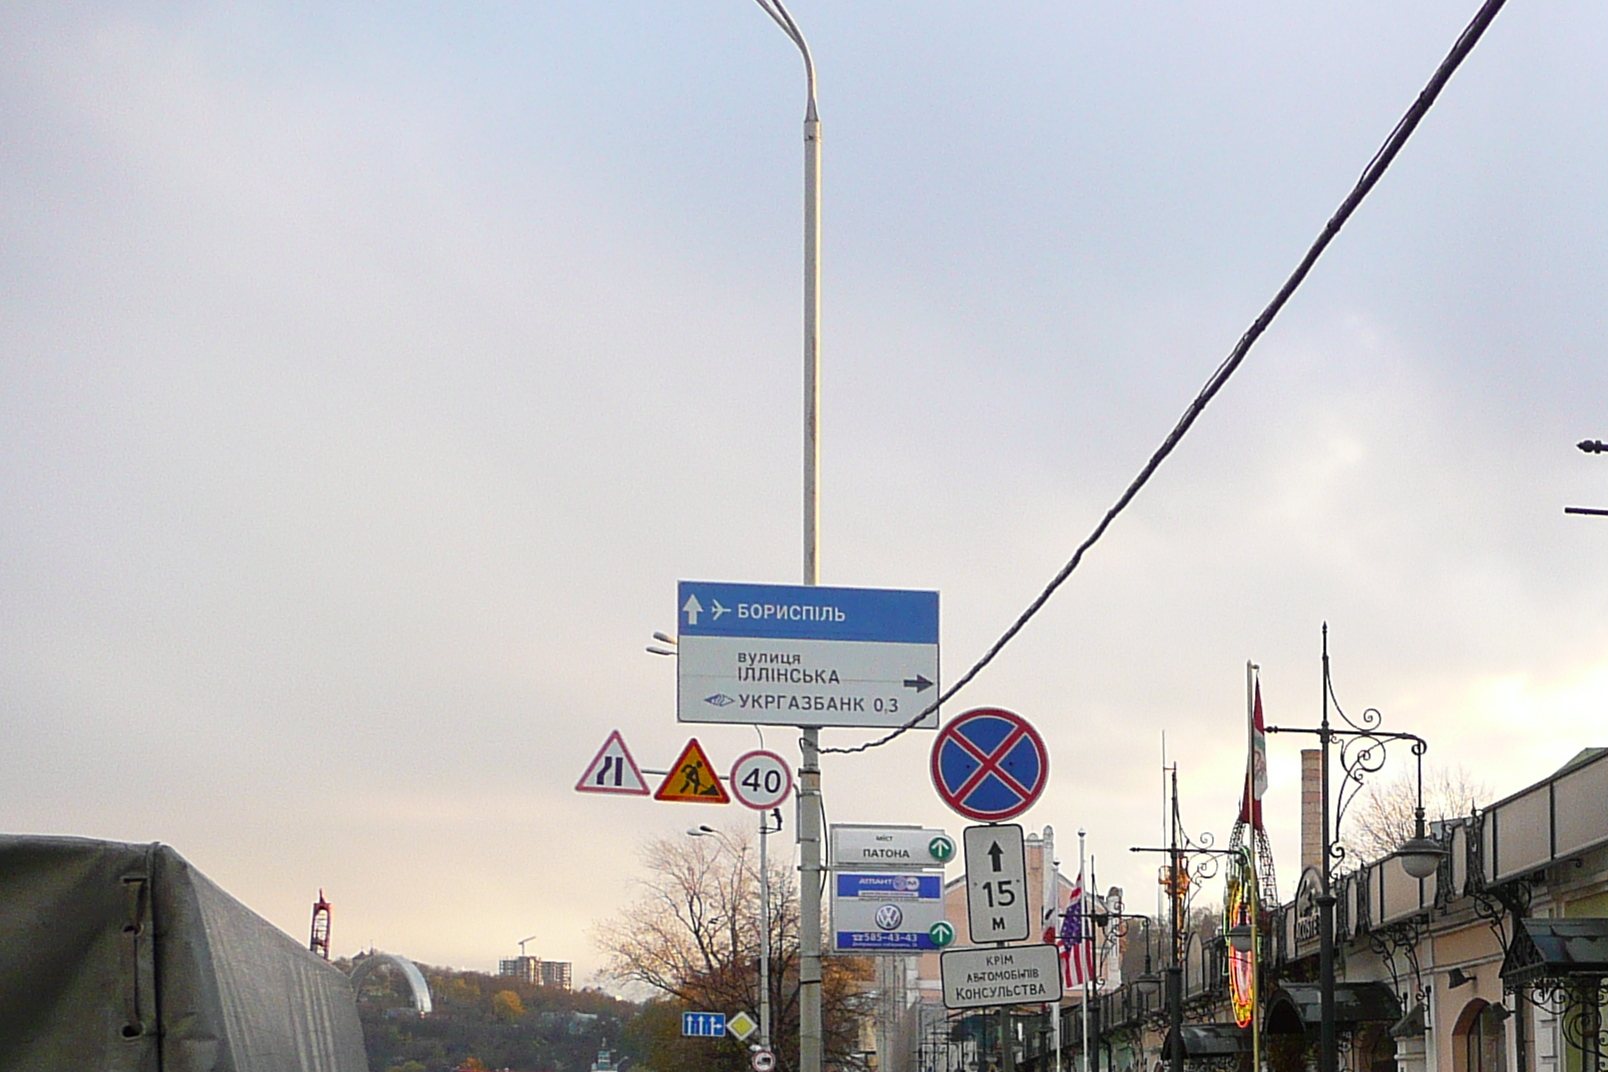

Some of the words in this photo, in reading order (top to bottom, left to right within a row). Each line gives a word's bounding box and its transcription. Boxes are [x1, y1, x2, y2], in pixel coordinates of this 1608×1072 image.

[738, 603, 846, 622] БОРИСПІЛЬ
[738, 652, 801, 667] вулиця
[738, 667, 840, 685] ІЛЛІНСЬКА
[738, 694, 865, 712] УКРГАЗБАНК
[873, 698, 899, 714] 0,3
[741, 768, 781, 793] 40
[863, 848, 910, 858] ПАТОНА
[982, 880, 1015, 908] 15
[986, 954, 1014, 966] КРІМ
